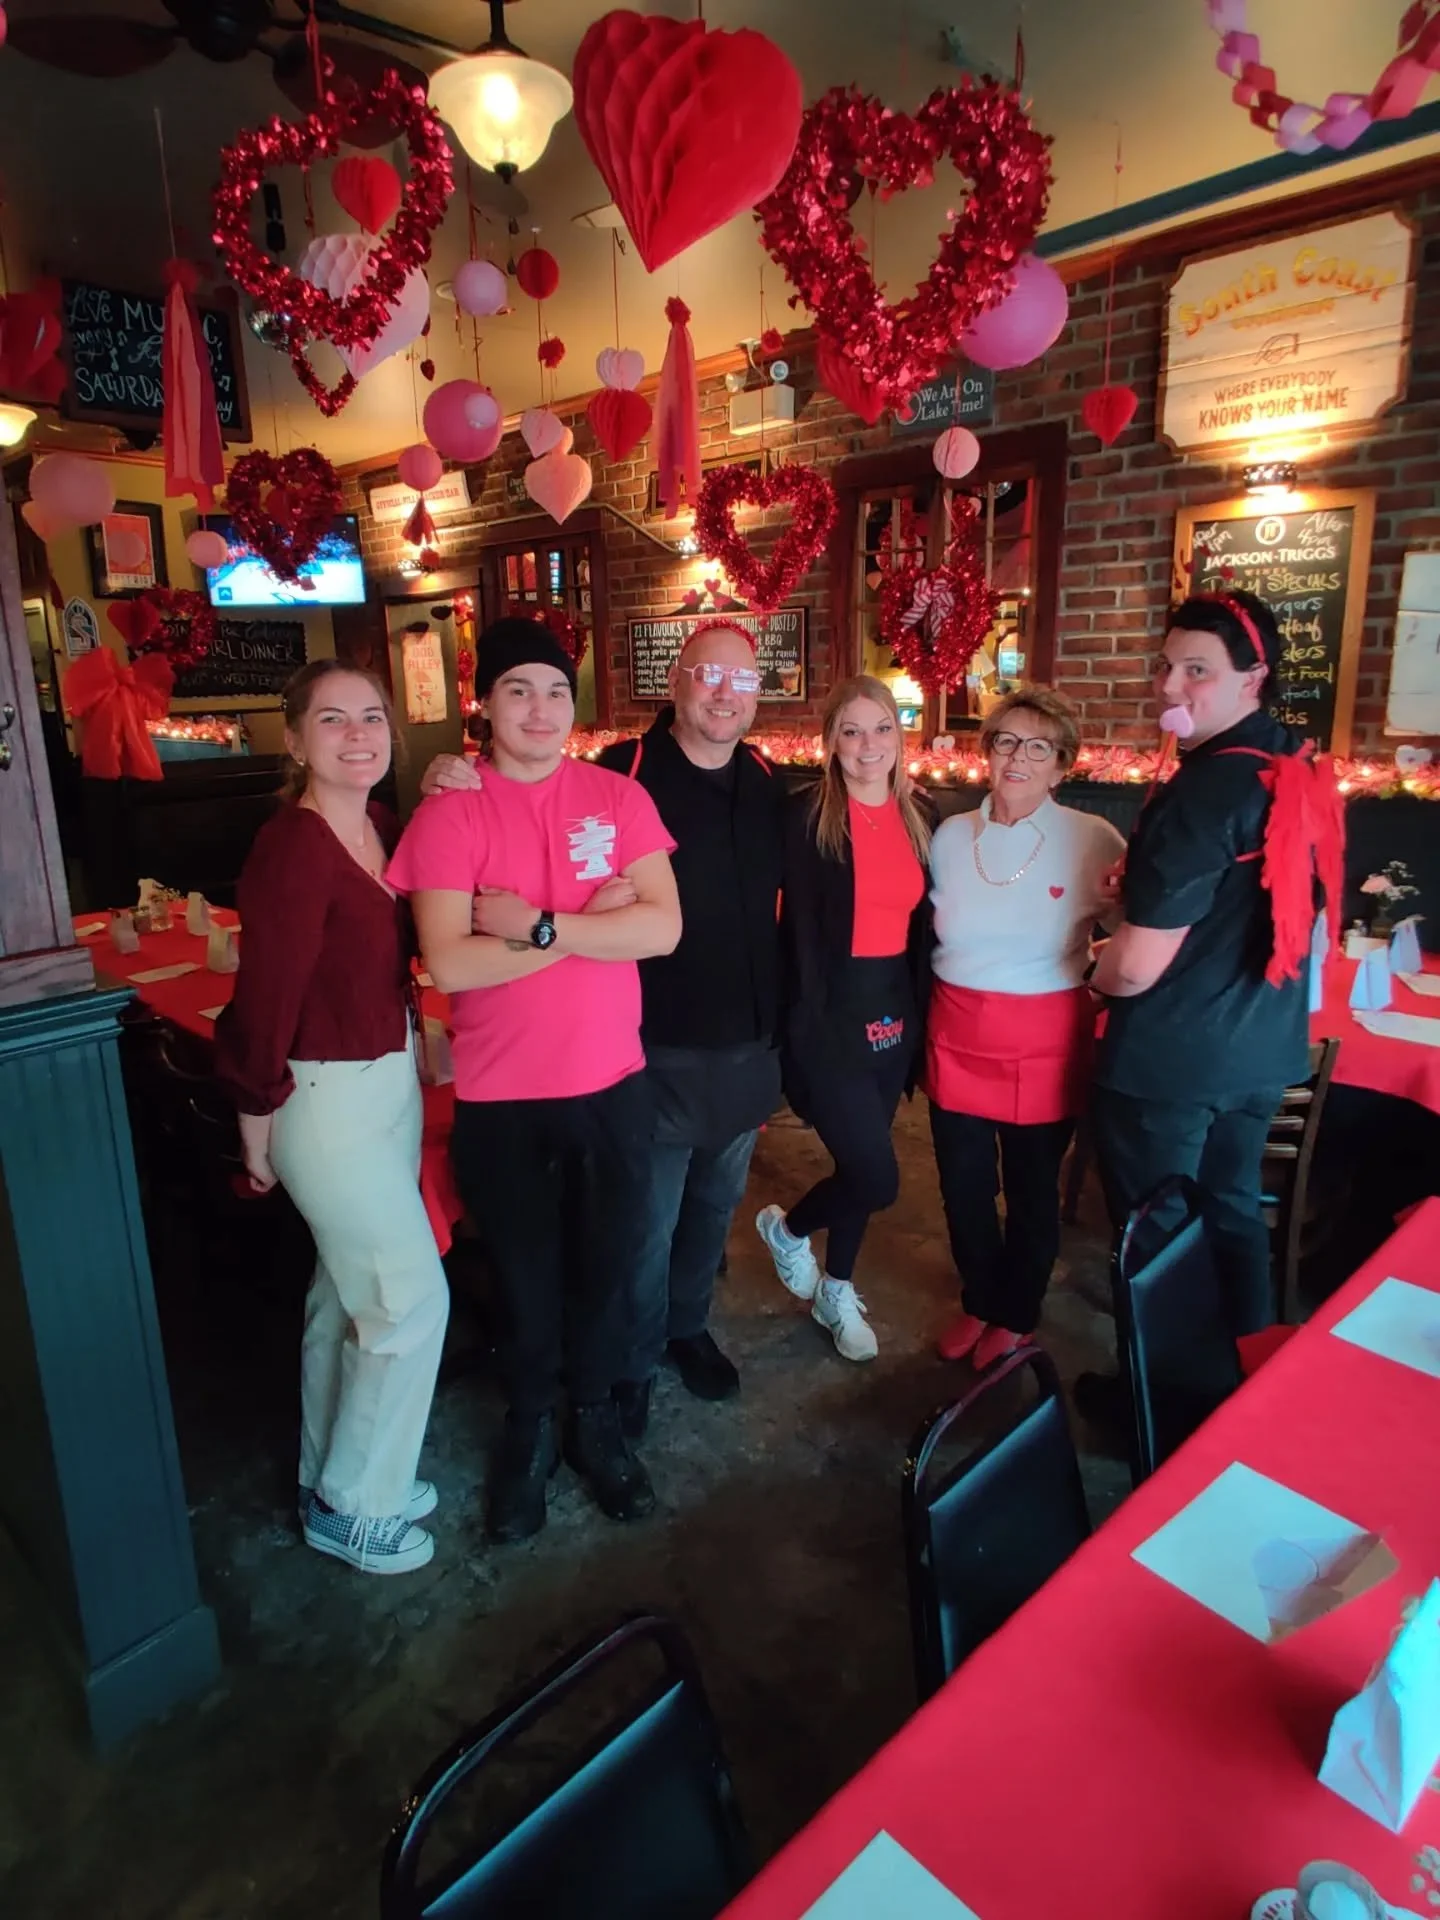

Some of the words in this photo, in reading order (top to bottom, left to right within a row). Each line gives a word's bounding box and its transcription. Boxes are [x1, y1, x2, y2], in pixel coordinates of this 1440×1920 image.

[1179, 262, 1277, 336] South
[75, 366, 164, 407] SATURDA
[921, 388, 938, 402] We
[963, 379, 983, 394] On
[1214, 379, 1257, 405] WHERE
[1259, 369, 1336, 393] EVERYBODY
[921, 402, 949, 420] Lake
[1198, 404, 1253, 430] KNOWS
[1257, 396, 1297, 419] YOUR
[1302, 386, 1349, 413] NAME
[1297, 528, 1332, 547] 4pm
[1203, 546, 1337, 571] JACKSON-TRIGGS
[644, 621, 682, 637] FLAVOURS
[770, 613, 797, 632] DUSTED
[765, 634, 782, 646] BBQ
[873, 1033, 902, 1052] LIGHT
